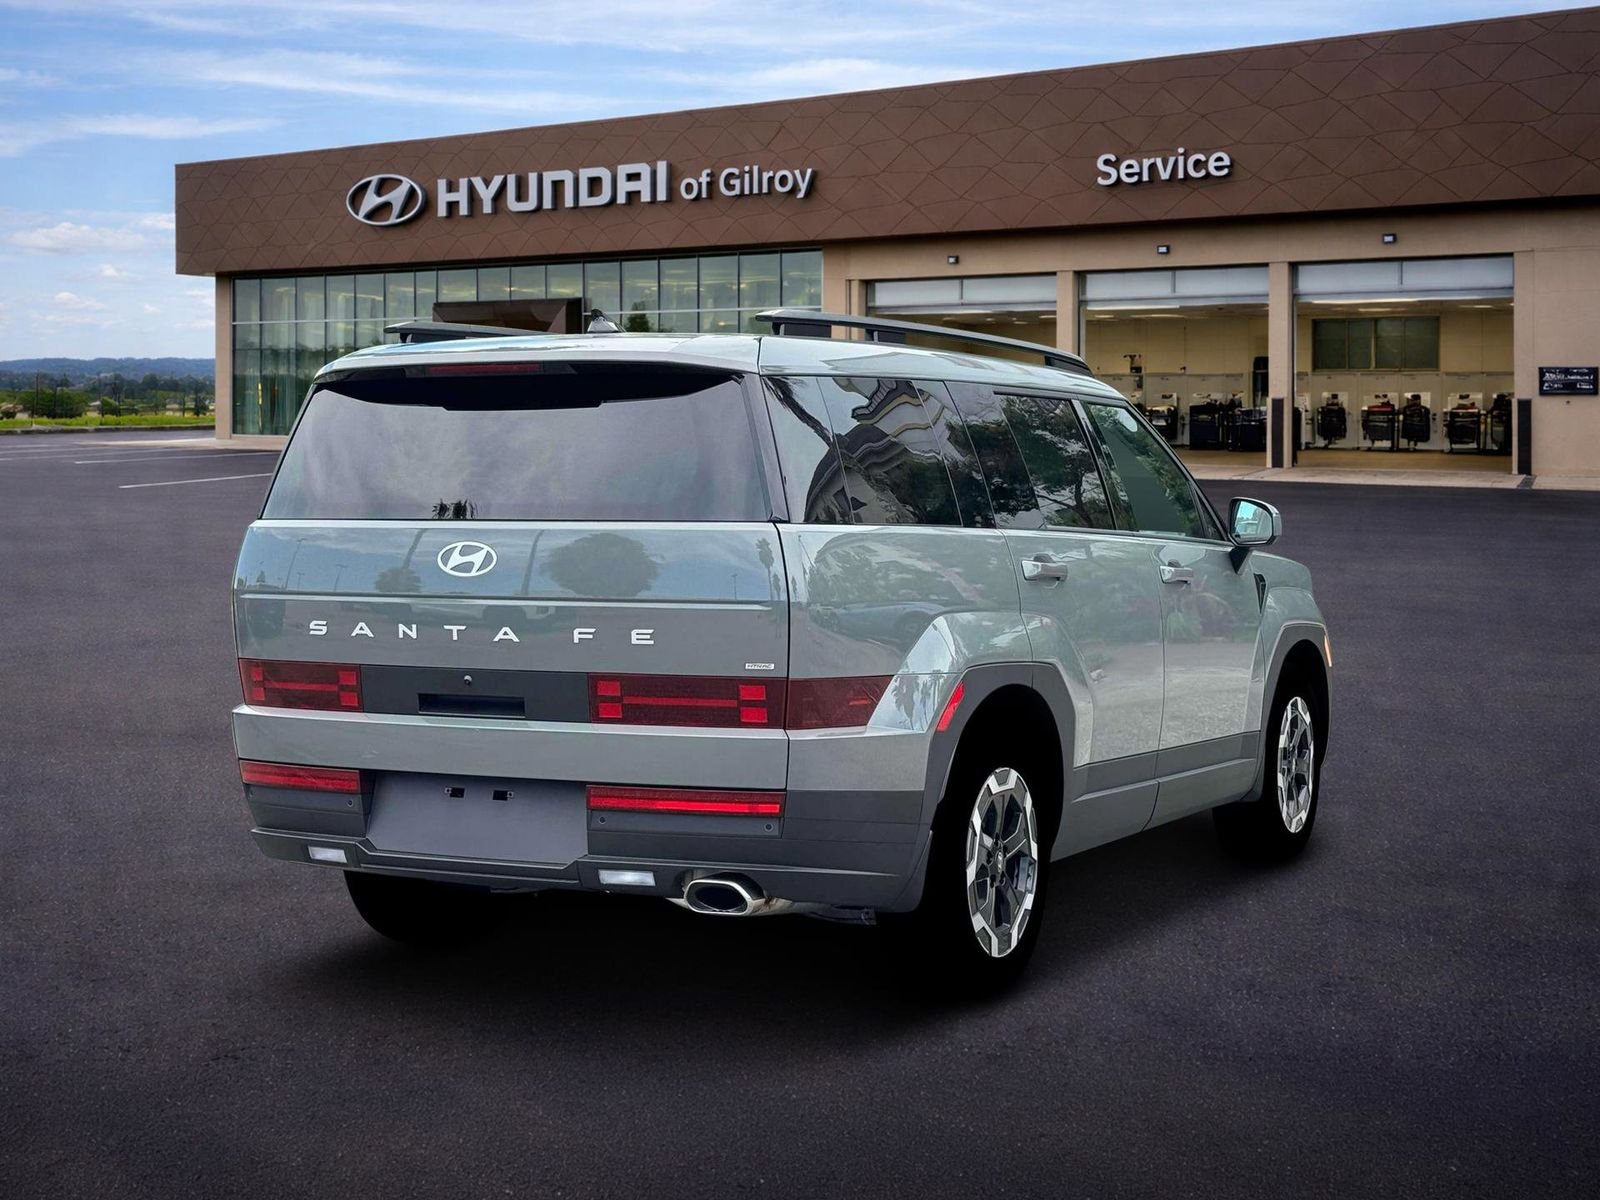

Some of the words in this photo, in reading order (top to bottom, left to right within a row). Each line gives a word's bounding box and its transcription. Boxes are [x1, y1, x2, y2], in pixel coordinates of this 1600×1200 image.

[1096, 147, 1231, 186] Service
[436, 160, 668, 217] HYUNDAI
[680, 169, 712, 199] of
[719, 165, 814, 198] Gilroy
[308, 620, 520, 643] SANTA
[572, 628, 655, 645] FE
